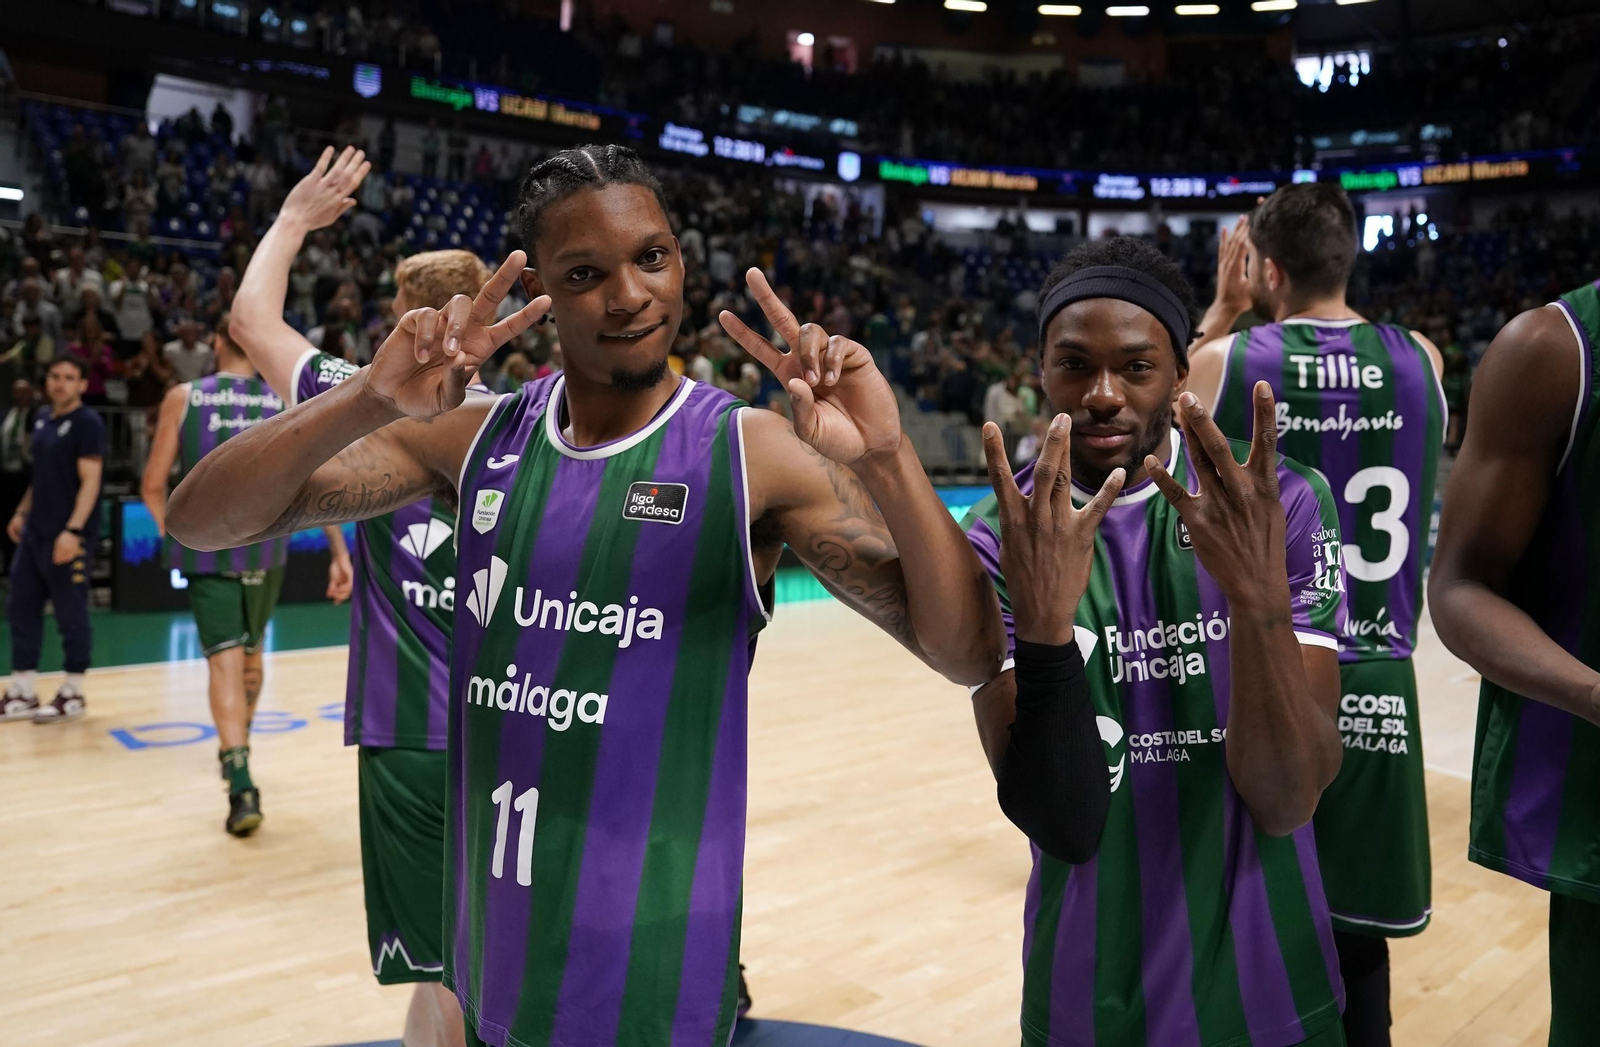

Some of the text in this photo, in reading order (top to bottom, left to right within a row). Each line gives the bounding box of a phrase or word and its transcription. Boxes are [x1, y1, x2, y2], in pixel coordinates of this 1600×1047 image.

[1289, 353, 1384, 389] Tillie
[632, 492, 655, 505] liga
[629, 504, 680, 518] endesa
[1311, 525, 1337, 542] sabor
[513, 586, 665, 649] Unicaja
[1110, 647, 1206, 685] Unicaja
[1340, 693, 1407, 717] COSTA
[1338, 716, 1409, 736] DEL SOL
[1128, 731, 1178, 747] COSTA
[1178, 730, 1208, 744] DEL
[1130, 747, 1191, 763] MÁLAGA
[491, 780, 540, 887] 11
